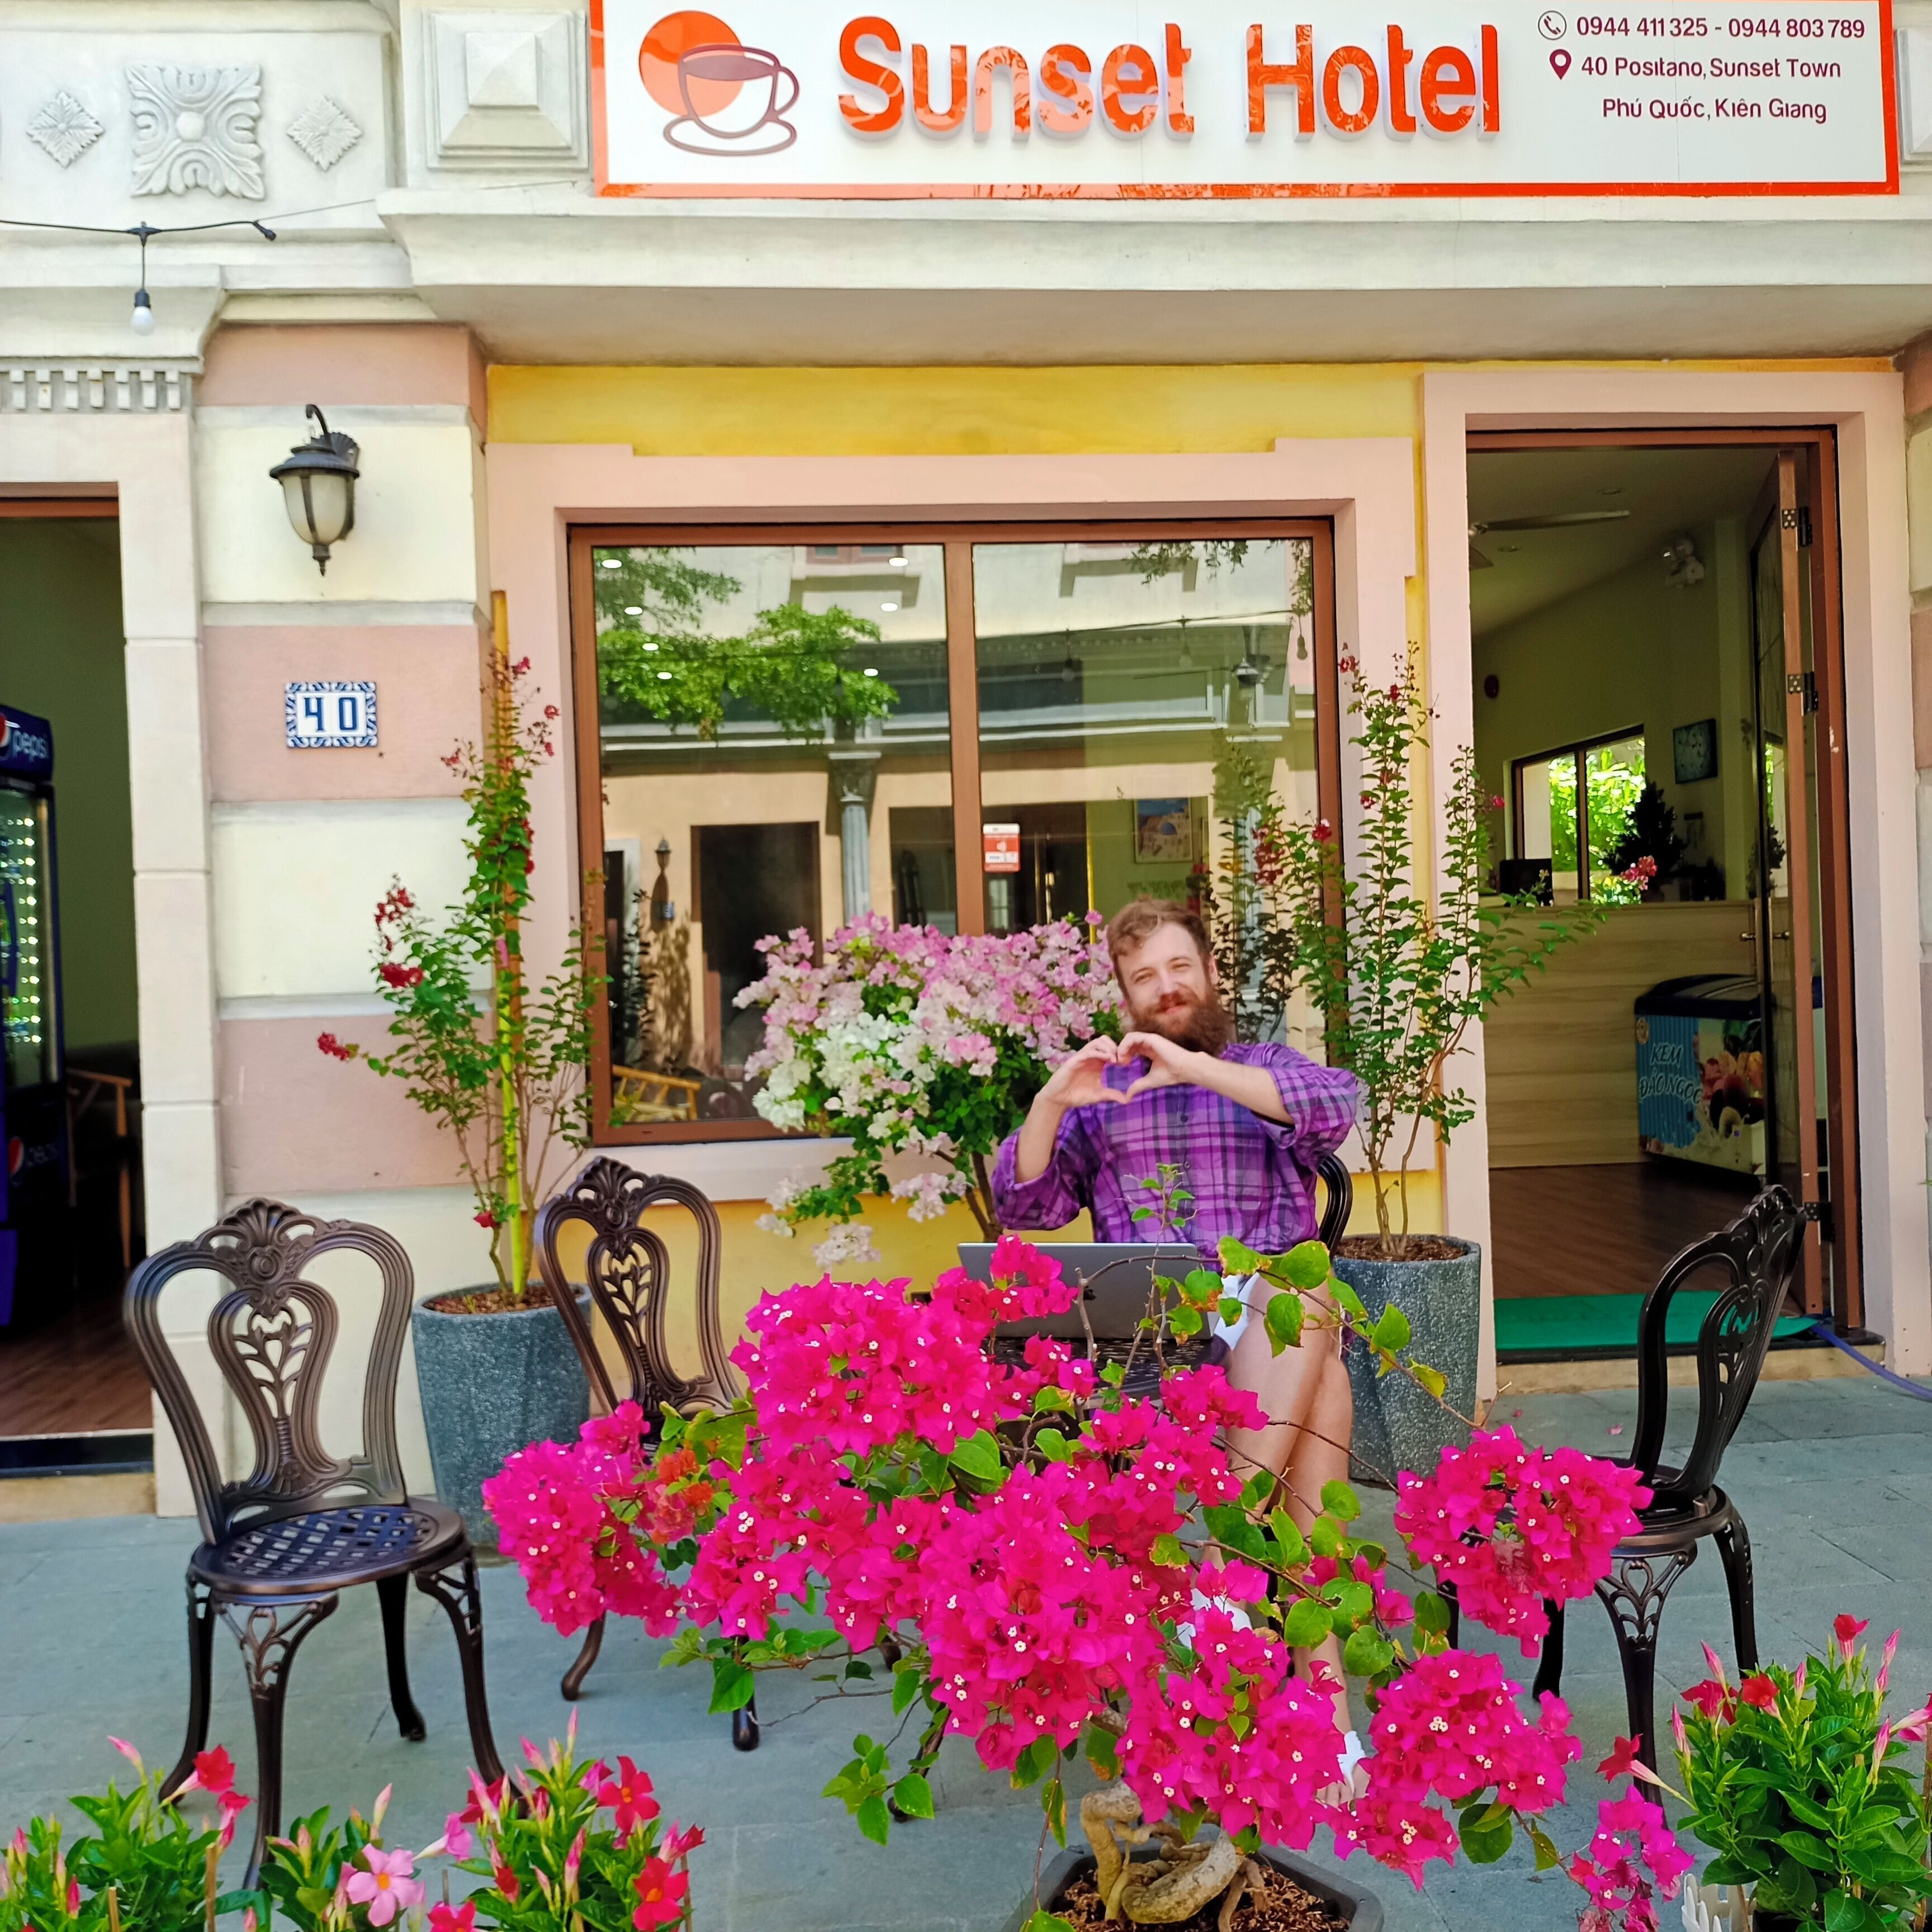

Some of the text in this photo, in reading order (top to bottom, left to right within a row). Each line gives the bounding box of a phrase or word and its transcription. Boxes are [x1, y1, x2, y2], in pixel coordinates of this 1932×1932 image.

[1576, 16, 1630, 36] 0944
[1729, 18, 1781, 37] 0944
[838, 16, 1500, 134] Sunset Hotel
[1581, 56, 1608, 75] 40
[1710, 58, 1781, 77] Sunset
[1786, 58, 1841, 78] Town
[1603, 97, 1642, 118] Phú
[1649, 96, 1711, 120] Quốc,
[303, 697, 358, 731] 40
[12, 729, 48, 763] peps
[1651, 1044, 1683, 1067] KEM
